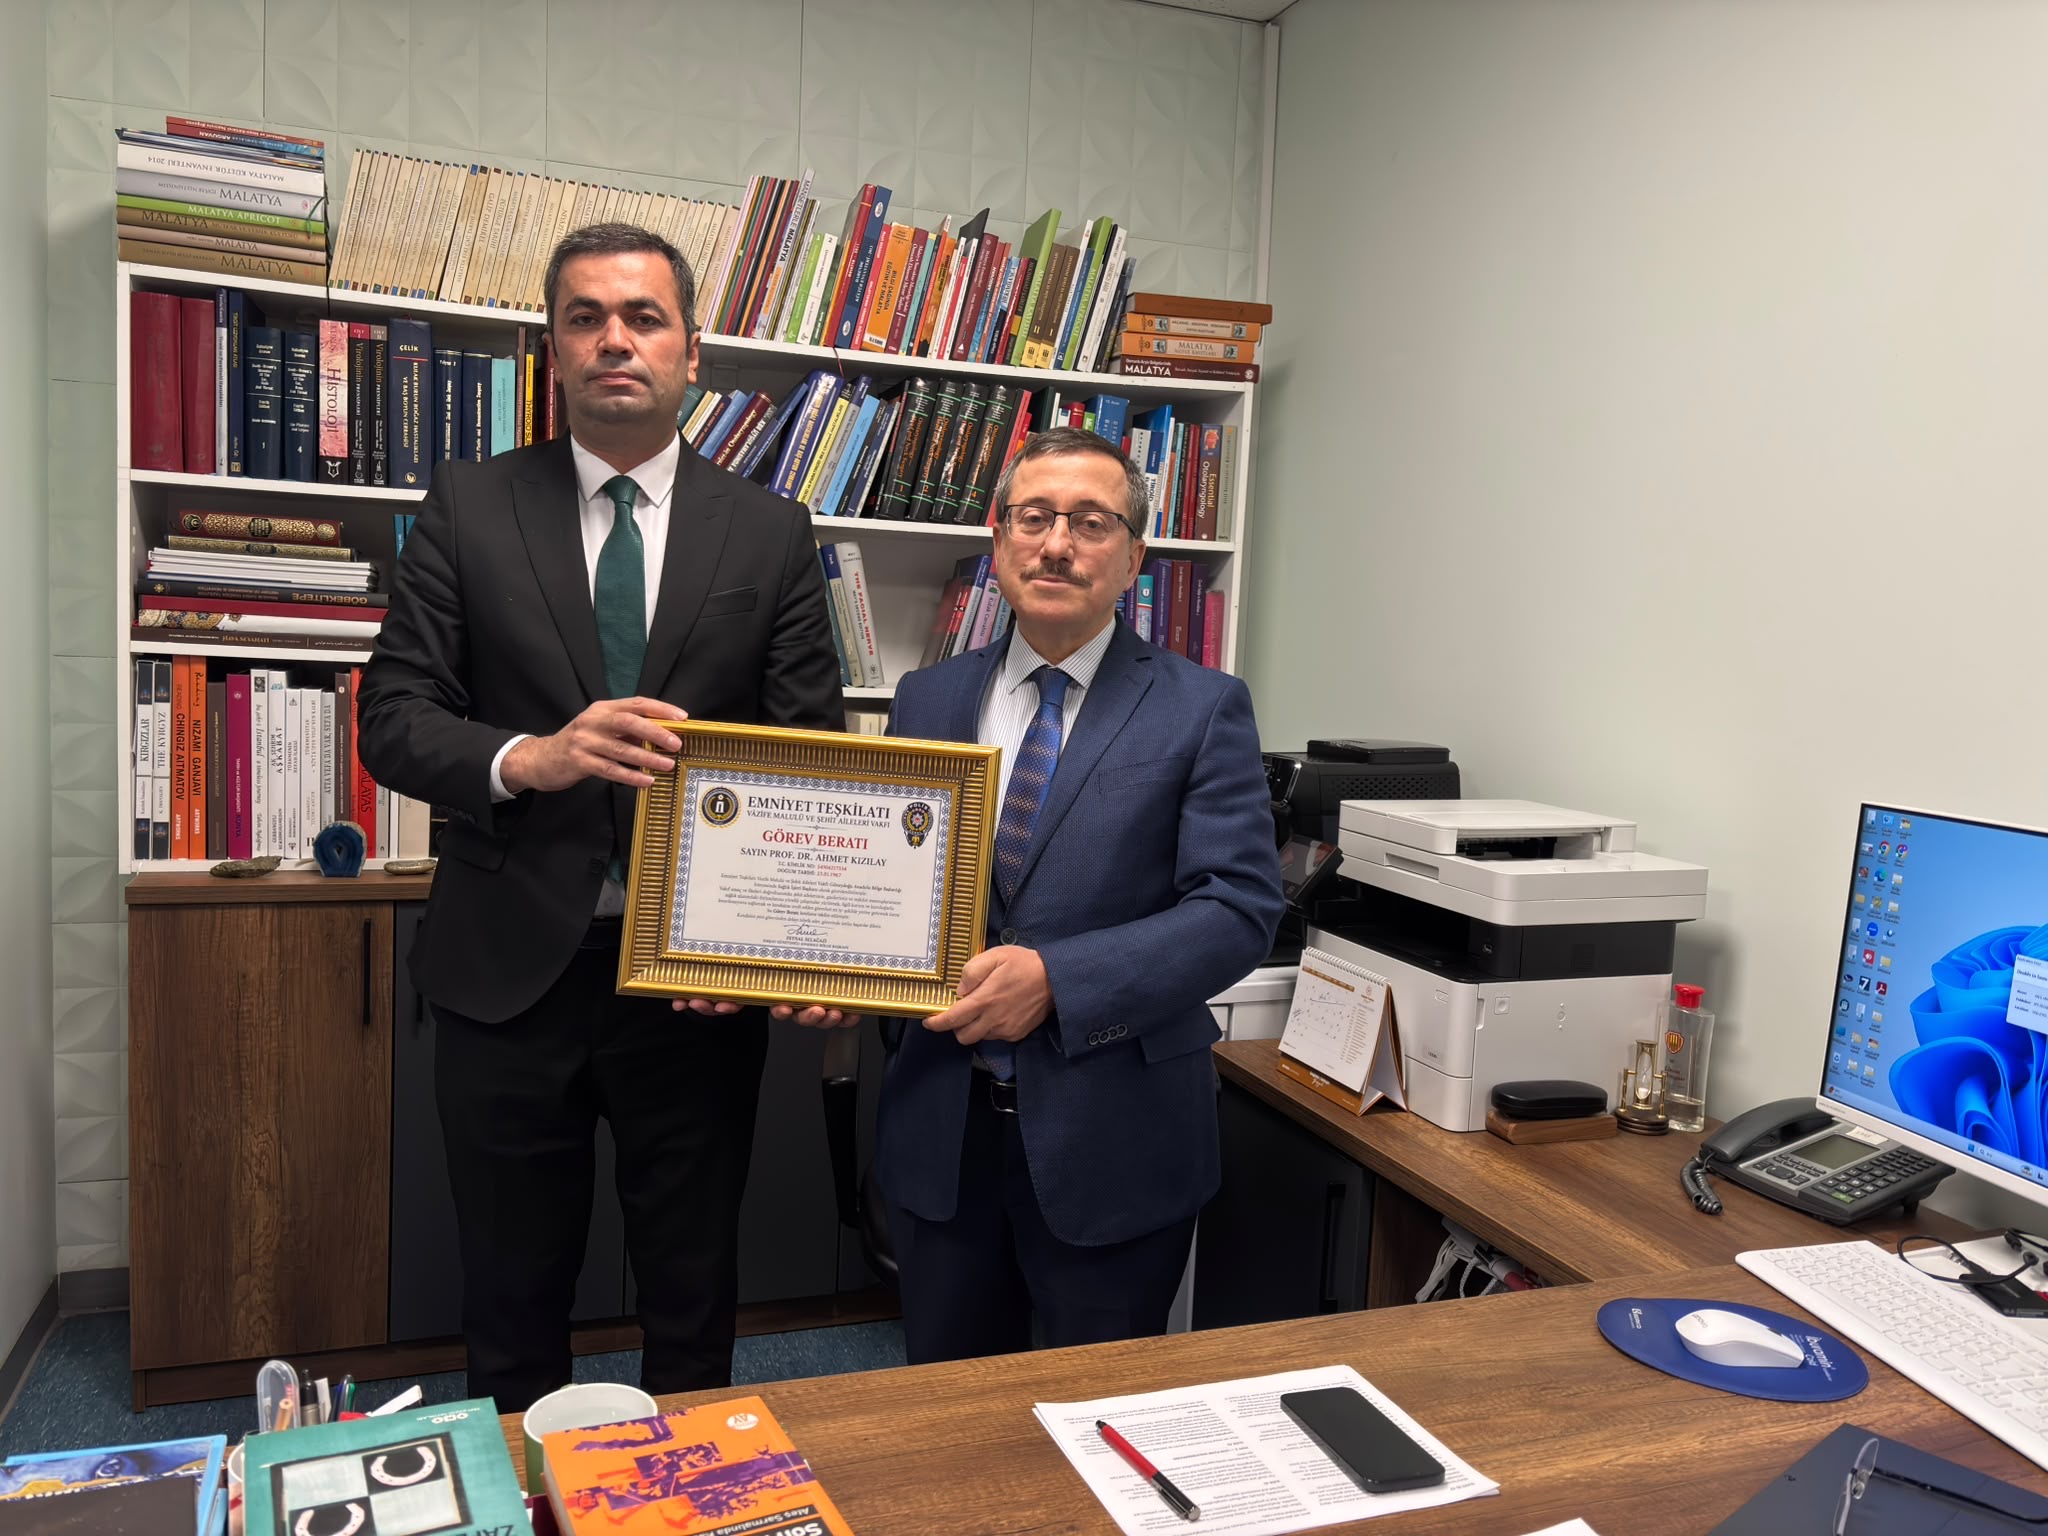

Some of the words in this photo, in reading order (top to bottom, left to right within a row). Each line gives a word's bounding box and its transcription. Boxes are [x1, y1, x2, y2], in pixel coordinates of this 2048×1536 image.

[146, 155, 166, 164] 2014
[247, 170, 285, 182] MALATYA
[217, 187, 283, 207] MALATYA
[140, 209, 209, 229] MALATYA
[186, 204, 235, 219] MALATYA
[235, 211, 281, 225] APRICOT
[213, 237, 259, 251] MALATYA
[778, 227, 796, 263] MALATYA
[219, 254, 295, 276] MALATYA
[873, 288, 887, 315] MALATYA
[399, 344, 419, 352] ÇELİK
[1177, 340, 1214, 352] MALATYA
[355, 343, 364, 383] Virolojinin
[375, 343, 383, 383] Virolojinin
[1124, 362, 1172, 377] MALATYA
[400, 384, 408, 395] BAŞ
[402, 376, 408, 384] VE
[412, 403, 420, 424] BOĞAZ
[524, 399, 532, 431] THYROID
[1197, 460, 1210, 519] Otolaryngology
[1206, 472, 1216, 508] Essential
[852, 570, 862, 590] THE
[853, 603, 862, 622] SECOND
[856, 590, 869, 624] FACIAL
[984, 596, 994, 612] Kulak
[857, 621, 865, 640] EDITION
[863, 625, 874, 656] NERVE
[156, 711, 166, 747] KYRGYZ
[175, 712, 185, 751] CHINGIZ
[191, 718, 201, 752] NIZAMI
[139, 718, 150, 762] KIRGIZLAR
[275, 725, 283, 774] AŞKABAT
[156, 749, 166, 768] THE
[324, 748, 331, 758] DA
[175, 753, 184, 800] AITMATOV
[192, 756, 202, 796] GANJAVI
[746, 792, 816, 813] EMNİYET
[814, 798, 891, 822] TEŞKİLATI
[805, 814, 815, 822] VE
[815, 814, 837, 825] ŞEHİT
[836, 816, 871, 827] AİLELERİ
[870, 820, 891, 829] VAKFI
[761, 826, 815, 846] GÖREV
[817, 833, 869, 850] BERATI
[739, 846, 767, 857] SAYIN
[769, 849, 795, 860] PROF.
[796, 851, 813, 861] DR.
[814, 853, 849, 864] AHMET
[849, 855, 887, 867] KIZILAY
